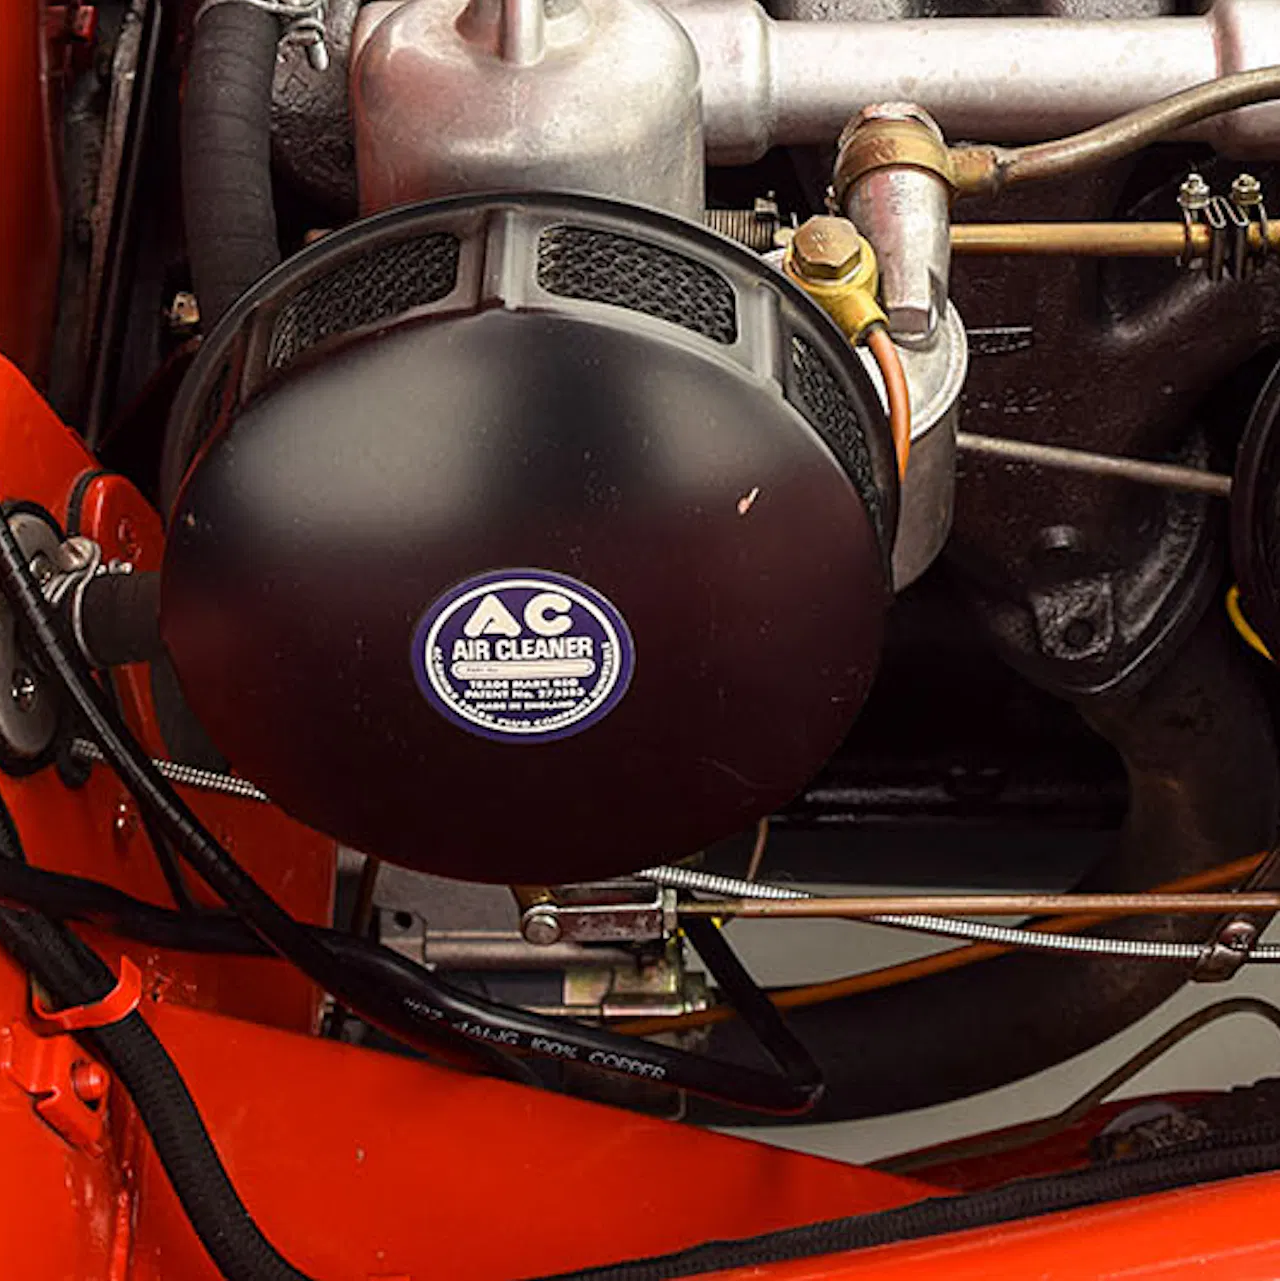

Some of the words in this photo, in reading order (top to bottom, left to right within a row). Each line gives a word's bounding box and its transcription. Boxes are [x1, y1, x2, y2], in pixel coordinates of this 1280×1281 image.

[464, 593, 573, 638] AC
[452, 639, 490, 661] AIR
[495, 636, 594, 660] CLEANER
[464, 689, 509, 699] PATENT
[587, 1050, 667, 1079] COPPER
